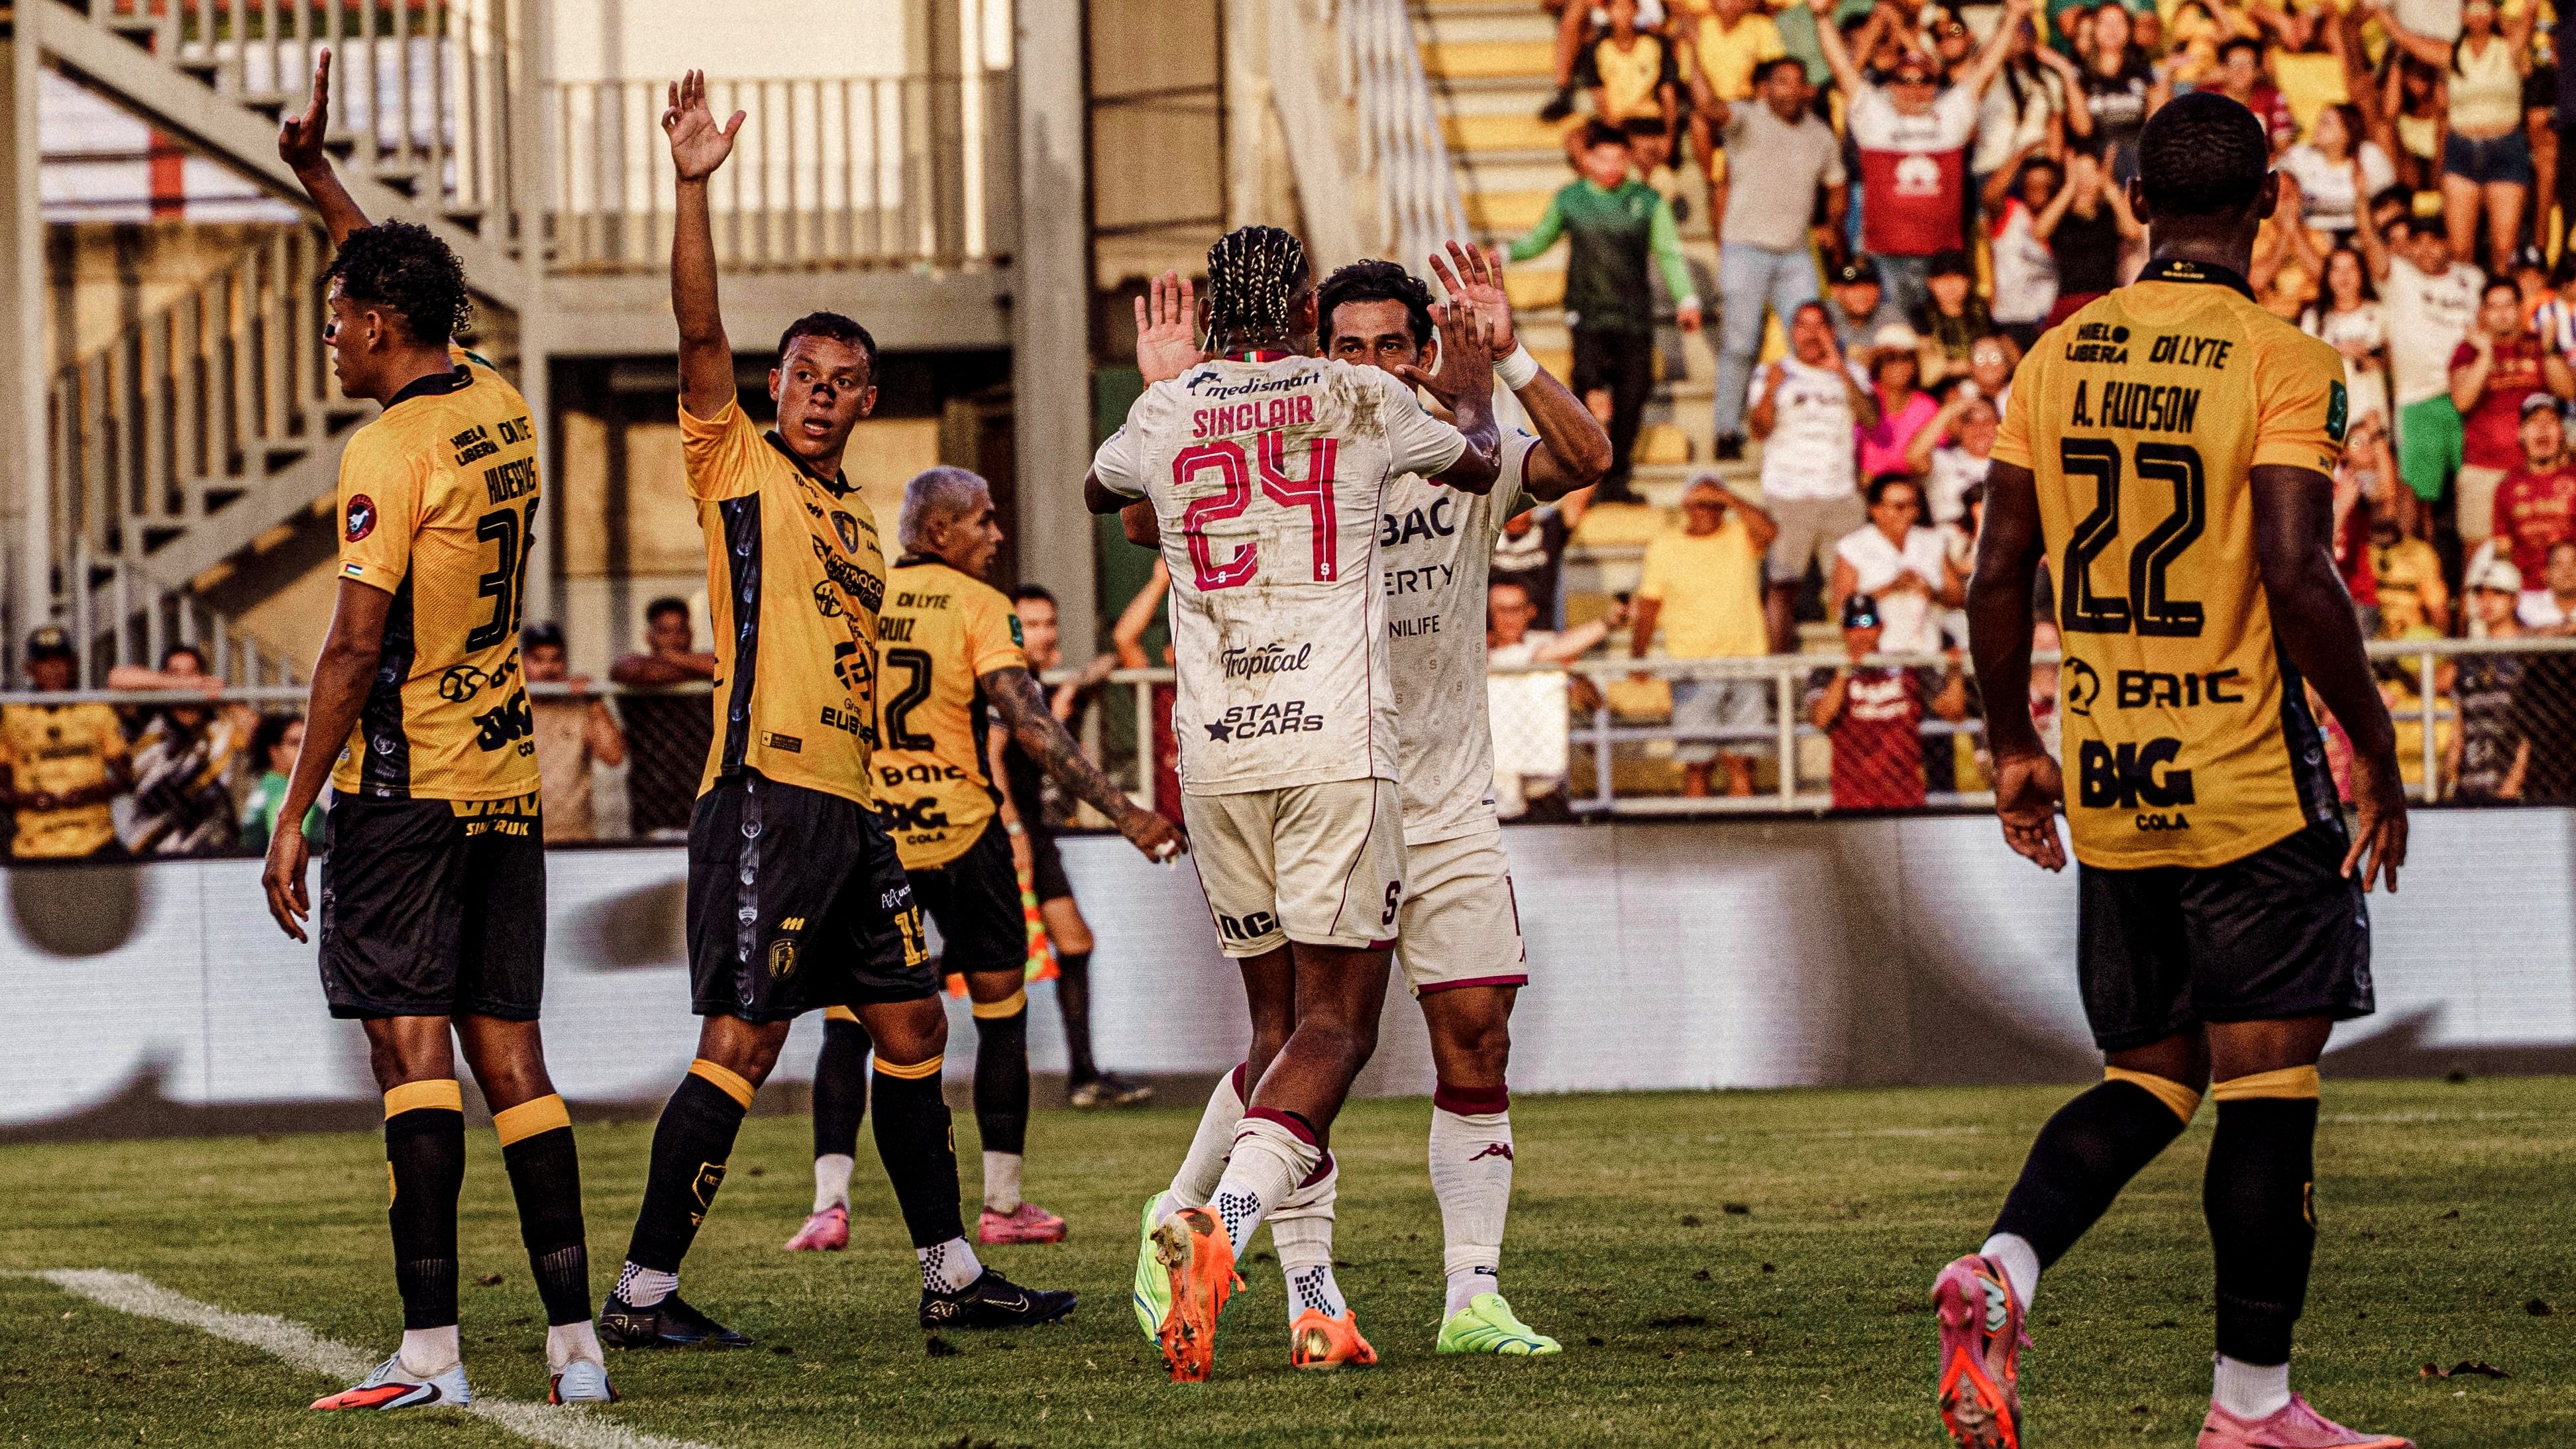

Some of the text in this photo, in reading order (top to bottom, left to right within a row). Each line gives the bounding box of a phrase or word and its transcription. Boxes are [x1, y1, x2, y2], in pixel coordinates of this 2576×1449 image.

[2180, 336, 2233, 369] LYTE
[1205, 372, 1321, 400] medismart
[1193, 394, 1315, 438] SINCLAIR
[2072, 380, 2094, 427] A.
[1171, 431, 1338, 592] 24
[2060, 437, 2206, 637] 22
[1384, 563, 1454, 596] ERTY
[877, 616, 916, 643] RUIZ
[1388, 614, 1440, 639] NILIFE
[1221, 642, 1311, 681] Tropical
[873, 647, 935, 751] 2
[1224, 700, 1305, 724] STAR
[1236, 715, 1324, 739] CARS
[517, 740, 535, 757] CO
[2080, 737, 2195, 808] BIG
[466, 819, 529, 836] SINRUK
[2136, 813, 2190, 831] COLA
[906, 832, 947, 846] COLA
[1381, 880, 1401, 926] S
